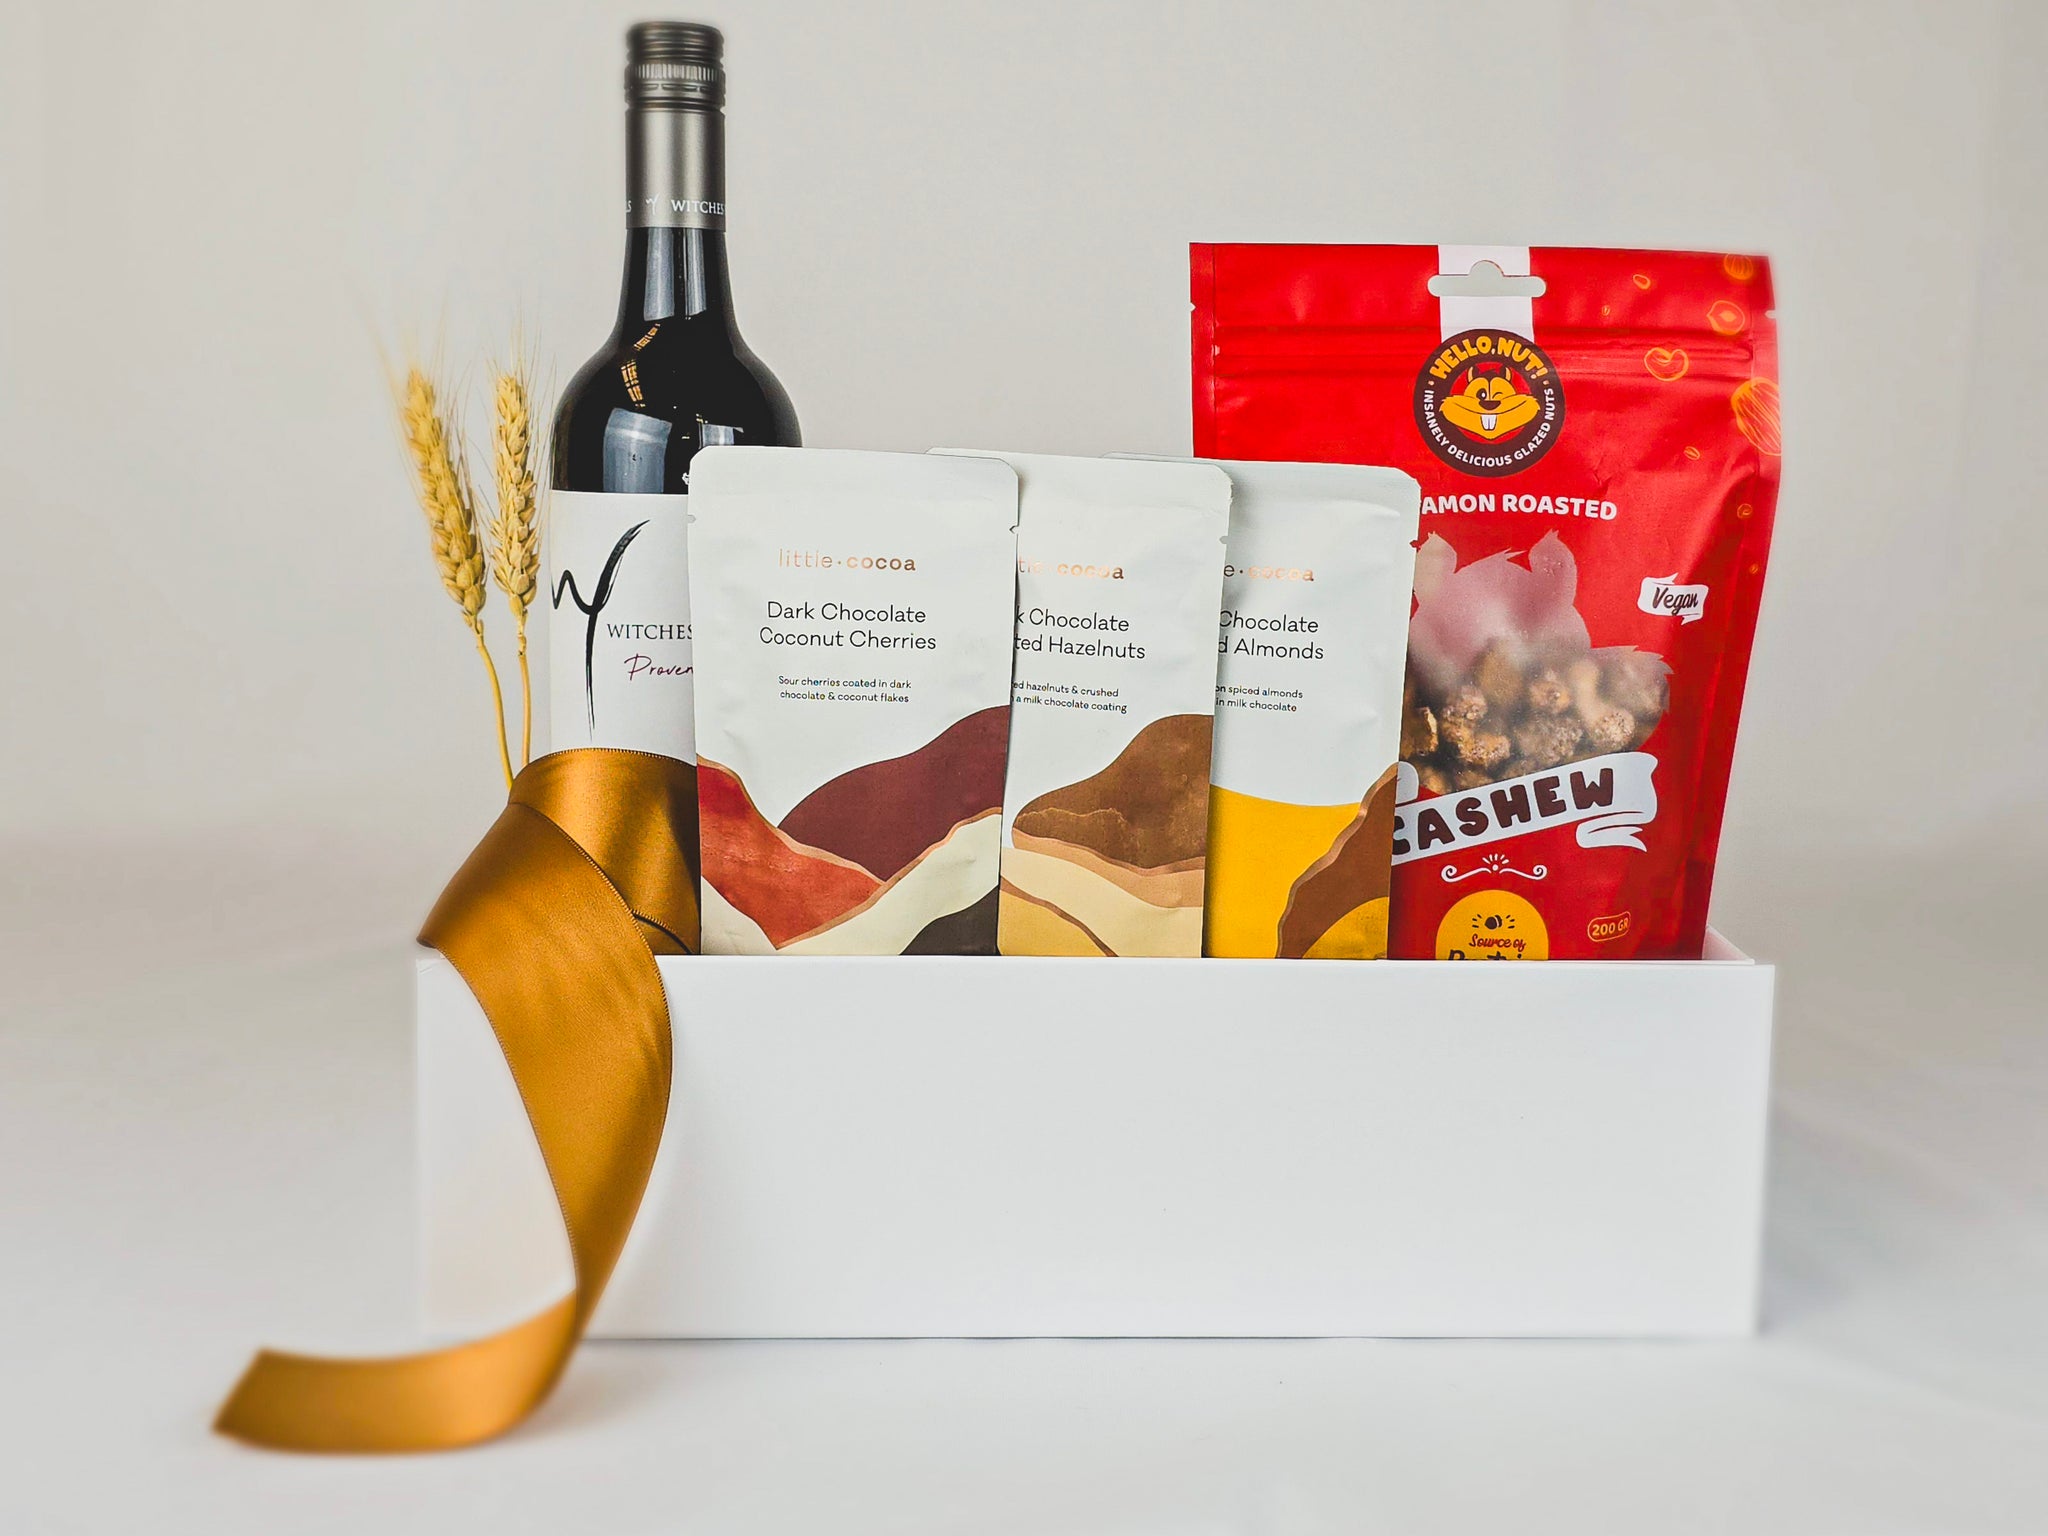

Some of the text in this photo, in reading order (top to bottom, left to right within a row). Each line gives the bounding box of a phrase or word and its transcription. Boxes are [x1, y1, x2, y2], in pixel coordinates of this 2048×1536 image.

[670, 199, 724, 215] WITCHES
[1423, 387, 1556, 468] INSANELY DELICIOUS GLAZED NUTS
[1502, 494, 1618, 521] ROASTED
[779, 548, 917, 572] little cocoa
[1057, 563, 1125, 580] cocoa
[1248, 565, 1315, 582] cocoa
[1652, 586, 1699, 616] Vegan
[767, 600, 927, 624] Dark Chocolate
[1029, 608, 1130, 632] Chocolate
[1219, 610, 1319, 633] Chocolate
[759, 626, 937, 650] Coconut Cherries
[1049, 635, 1146, 660] Hazelnuts
[1233, 638, 1324, 660] Almonds
[778, 675, 912, 689] Sour cherries coated in dark
[1026, 682, 1070, 694] hazelnuts
[1071, 685, 1079, 695] &
[1080, 688, 1119, 698] crushed
[780, 690, 909, 703] chocolate & coconut flakes
[1228, 686, 1260, 696] spiced
[1262, 688, 1304, 699] almonds
[1023, 695, 1042, 705] milk
[1044, 698, 1090, 710] chocolate
[1091, 704, 1128, 715] coating
[1227, 699, 1247, 708] milk
[1249, 700, 1298, 712] chocolate
[1592, 922, 1616, 936] 200
[1468, 933, 1527, 953] Source of
